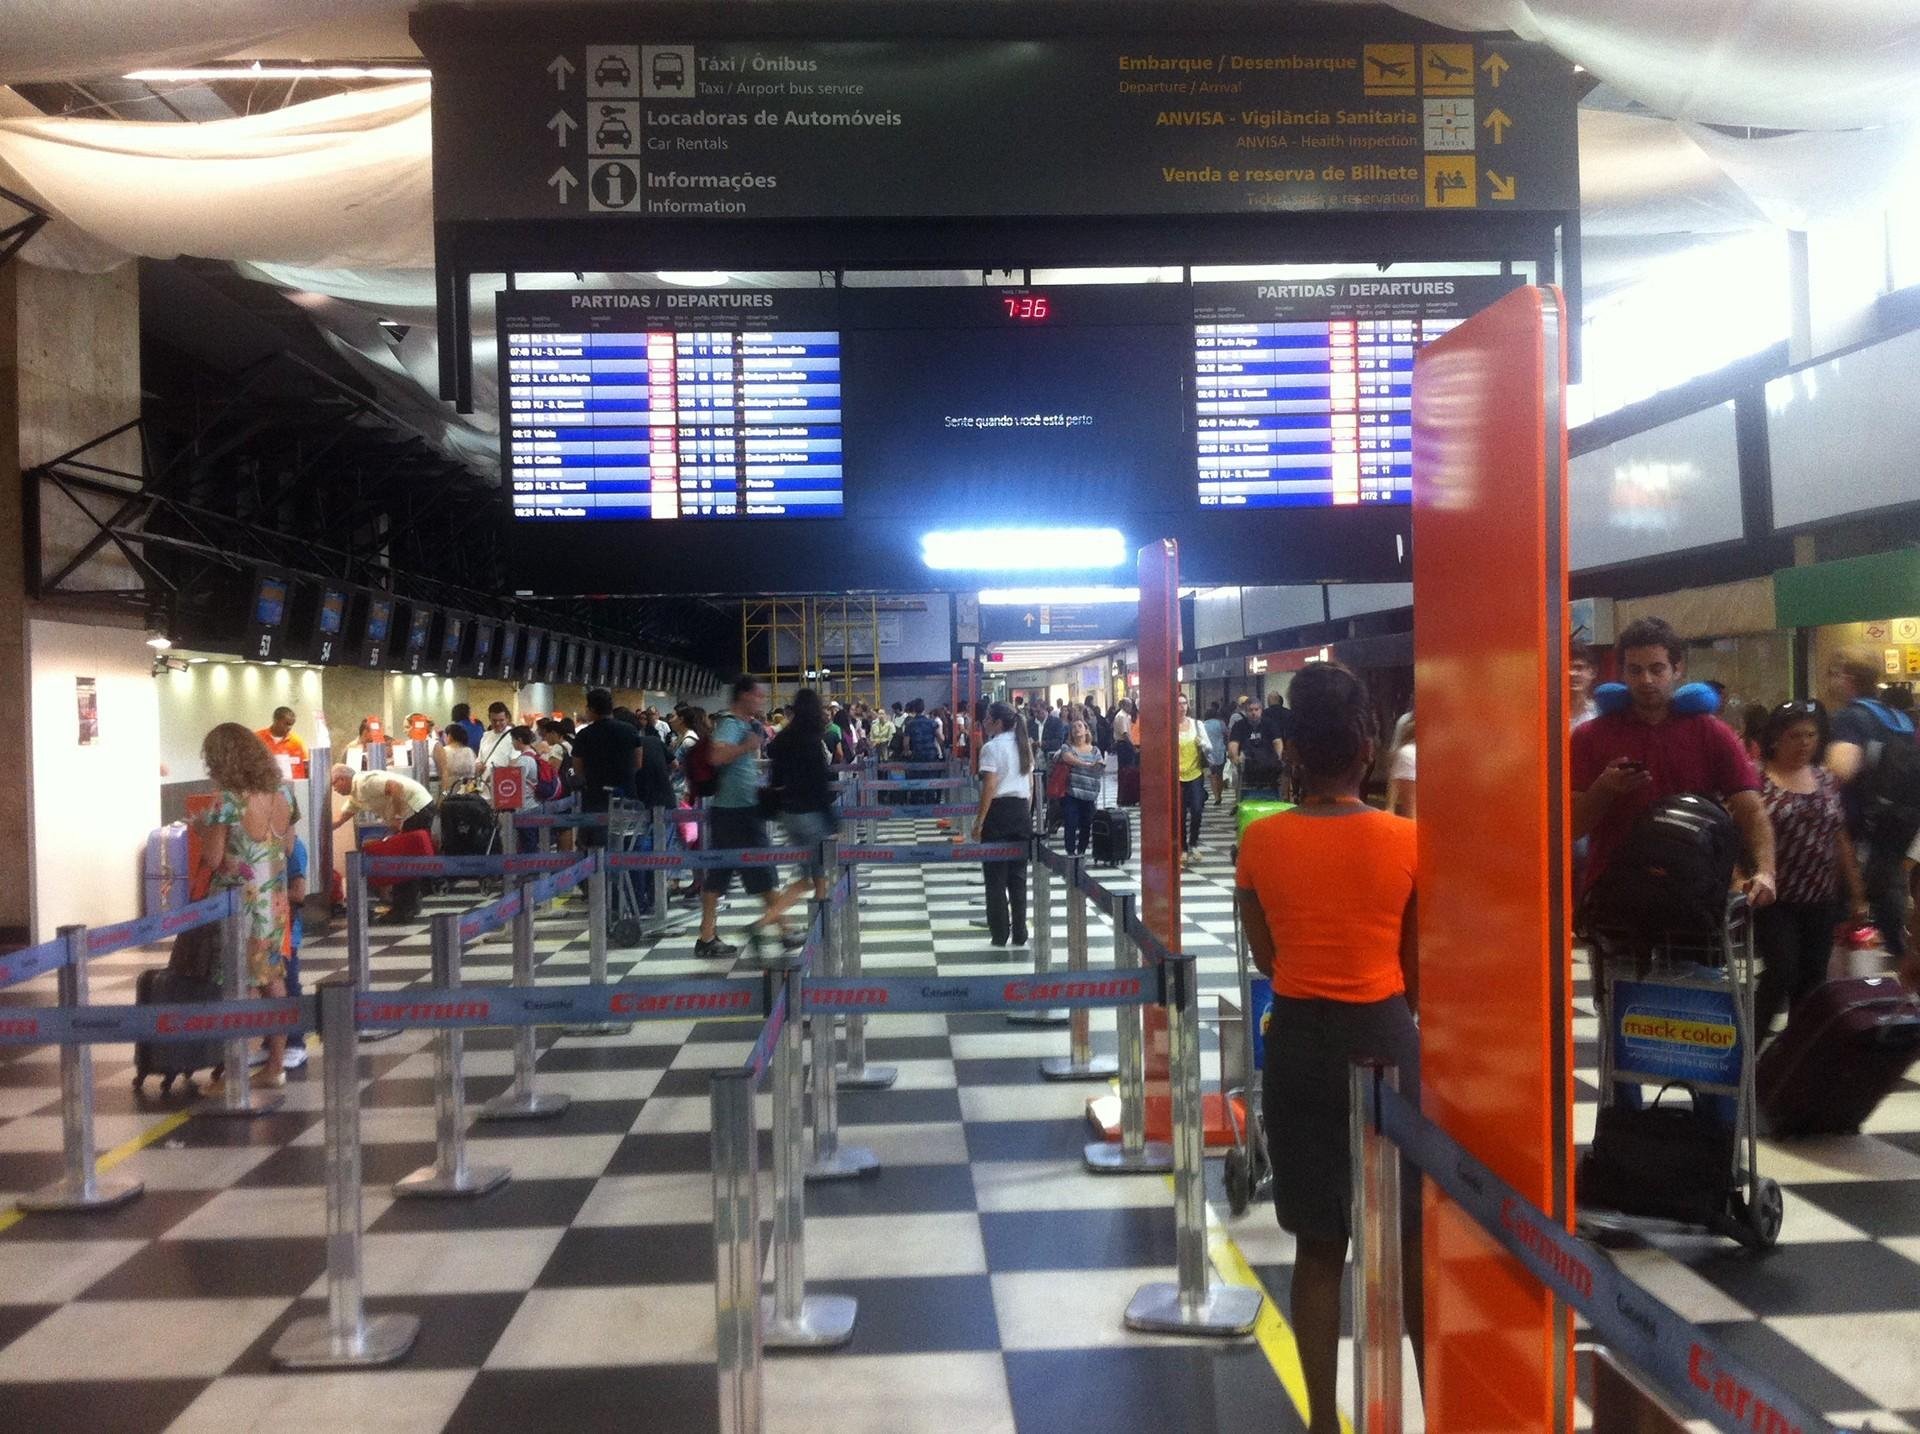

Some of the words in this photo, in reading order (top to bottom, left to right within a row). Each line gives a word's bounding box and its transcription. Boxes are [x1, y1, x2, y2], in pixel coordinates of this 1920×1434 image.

[699, 56, 736, 72] Táxi
[752, 52, 818, 72] Ônibus
[1119, 56, 1213, 75] Embarque
[1230, 55, 1357, 74] Desembarque
[699, 82, 724, 95] Taxi
[736, 82, 785, 97] Airport
[789, 82, 814, 95] bus
[817, 83, 865, 96] service
[648, 110, 748, 127] Locadoras
[753, 110, 779, 127] de
[784, 110, 902, 127] Automóveis
[1155, 111, 1225, 127] ANVISA
[647, 136, 671, 151] Car
[676, 136, 729, 151] Rentals
[1236, 136, 1289, 149] ANVISA
[1301, 134, 1345, 148] Health
[648, 171, 778, 192] Informações
[1162, 167, 1222, 183] Venda
[1228, 170, 1240, 183] e
[1245, 167, 1317, 182] reserva
[1322, 165, 1346, 182] de
[1352, 164, 1419, 181] Bilhete
[648, 199, 747, 214] Information
[1257, 284, 1336, 299] PARTIDAS
[1350, 281, 1456, 297] DEPARTURES
[571, 295, 651, 309] PARTIDAS
[666, 293, 774, 308] DEPARTURES
[1003, 298, 1048, 318] 7:36
[944, 414, 974, 428] Sente
[975, 414, 1013, 430] quando
[1042, 413, 1064, 427] está
[1065, 414, 1093, 429] perto
[258, 634, 272, 657] 53
[1002, 978, 1140, 1003] Carmim
[607, 989, 751, 1015] Carmim
[156, 1006, 303, 1035] Carmim
[1623, 1021, 1677, 1039] mack
[1680, 1027, 1733, 1046] color
[1500, 1196, 1595, 1299] Carmim
